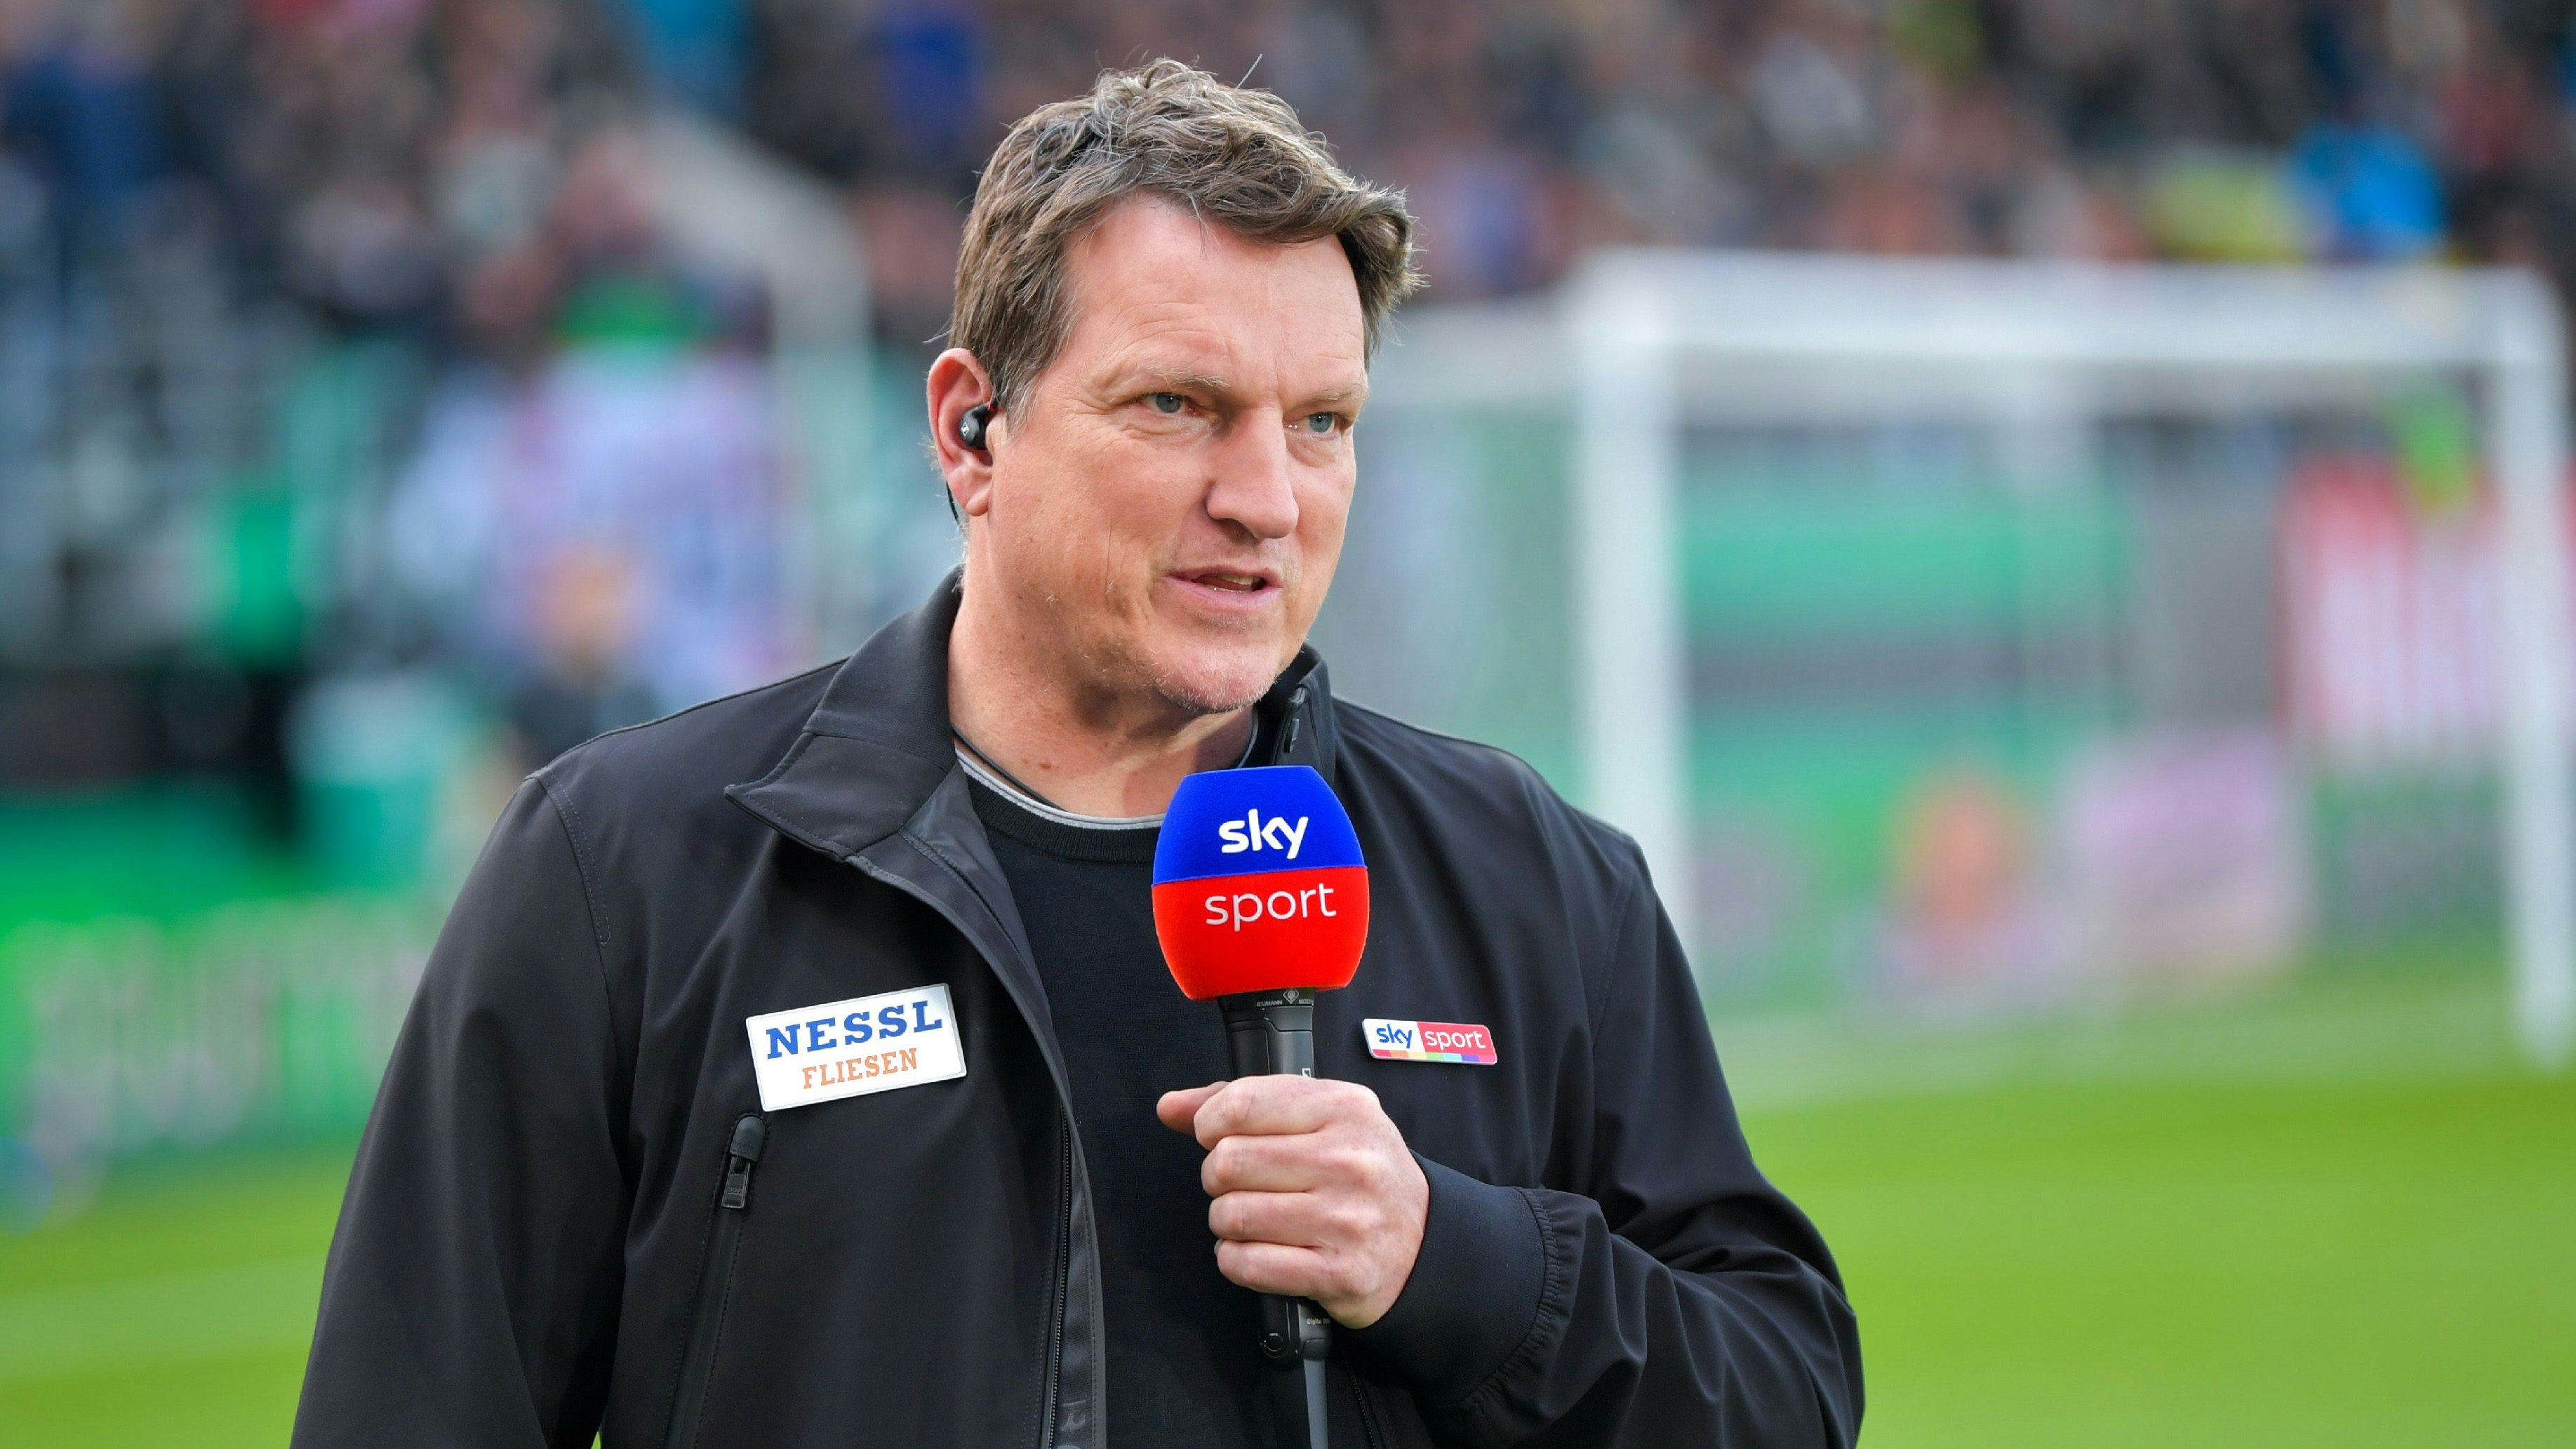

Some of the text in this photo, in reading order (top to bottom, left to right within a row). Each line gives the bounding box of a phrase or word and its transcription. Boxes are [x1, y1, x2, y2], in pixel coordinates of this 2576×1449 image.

[1219, 808, 1309, 859] sky
[1205, 883, 1337, 932] sport
[766, 1000, 942, 1060] NESSL
[1376, 1023, 1486, 1050] sky sport
[802, 1048, 917, 1089] FLIESEN
